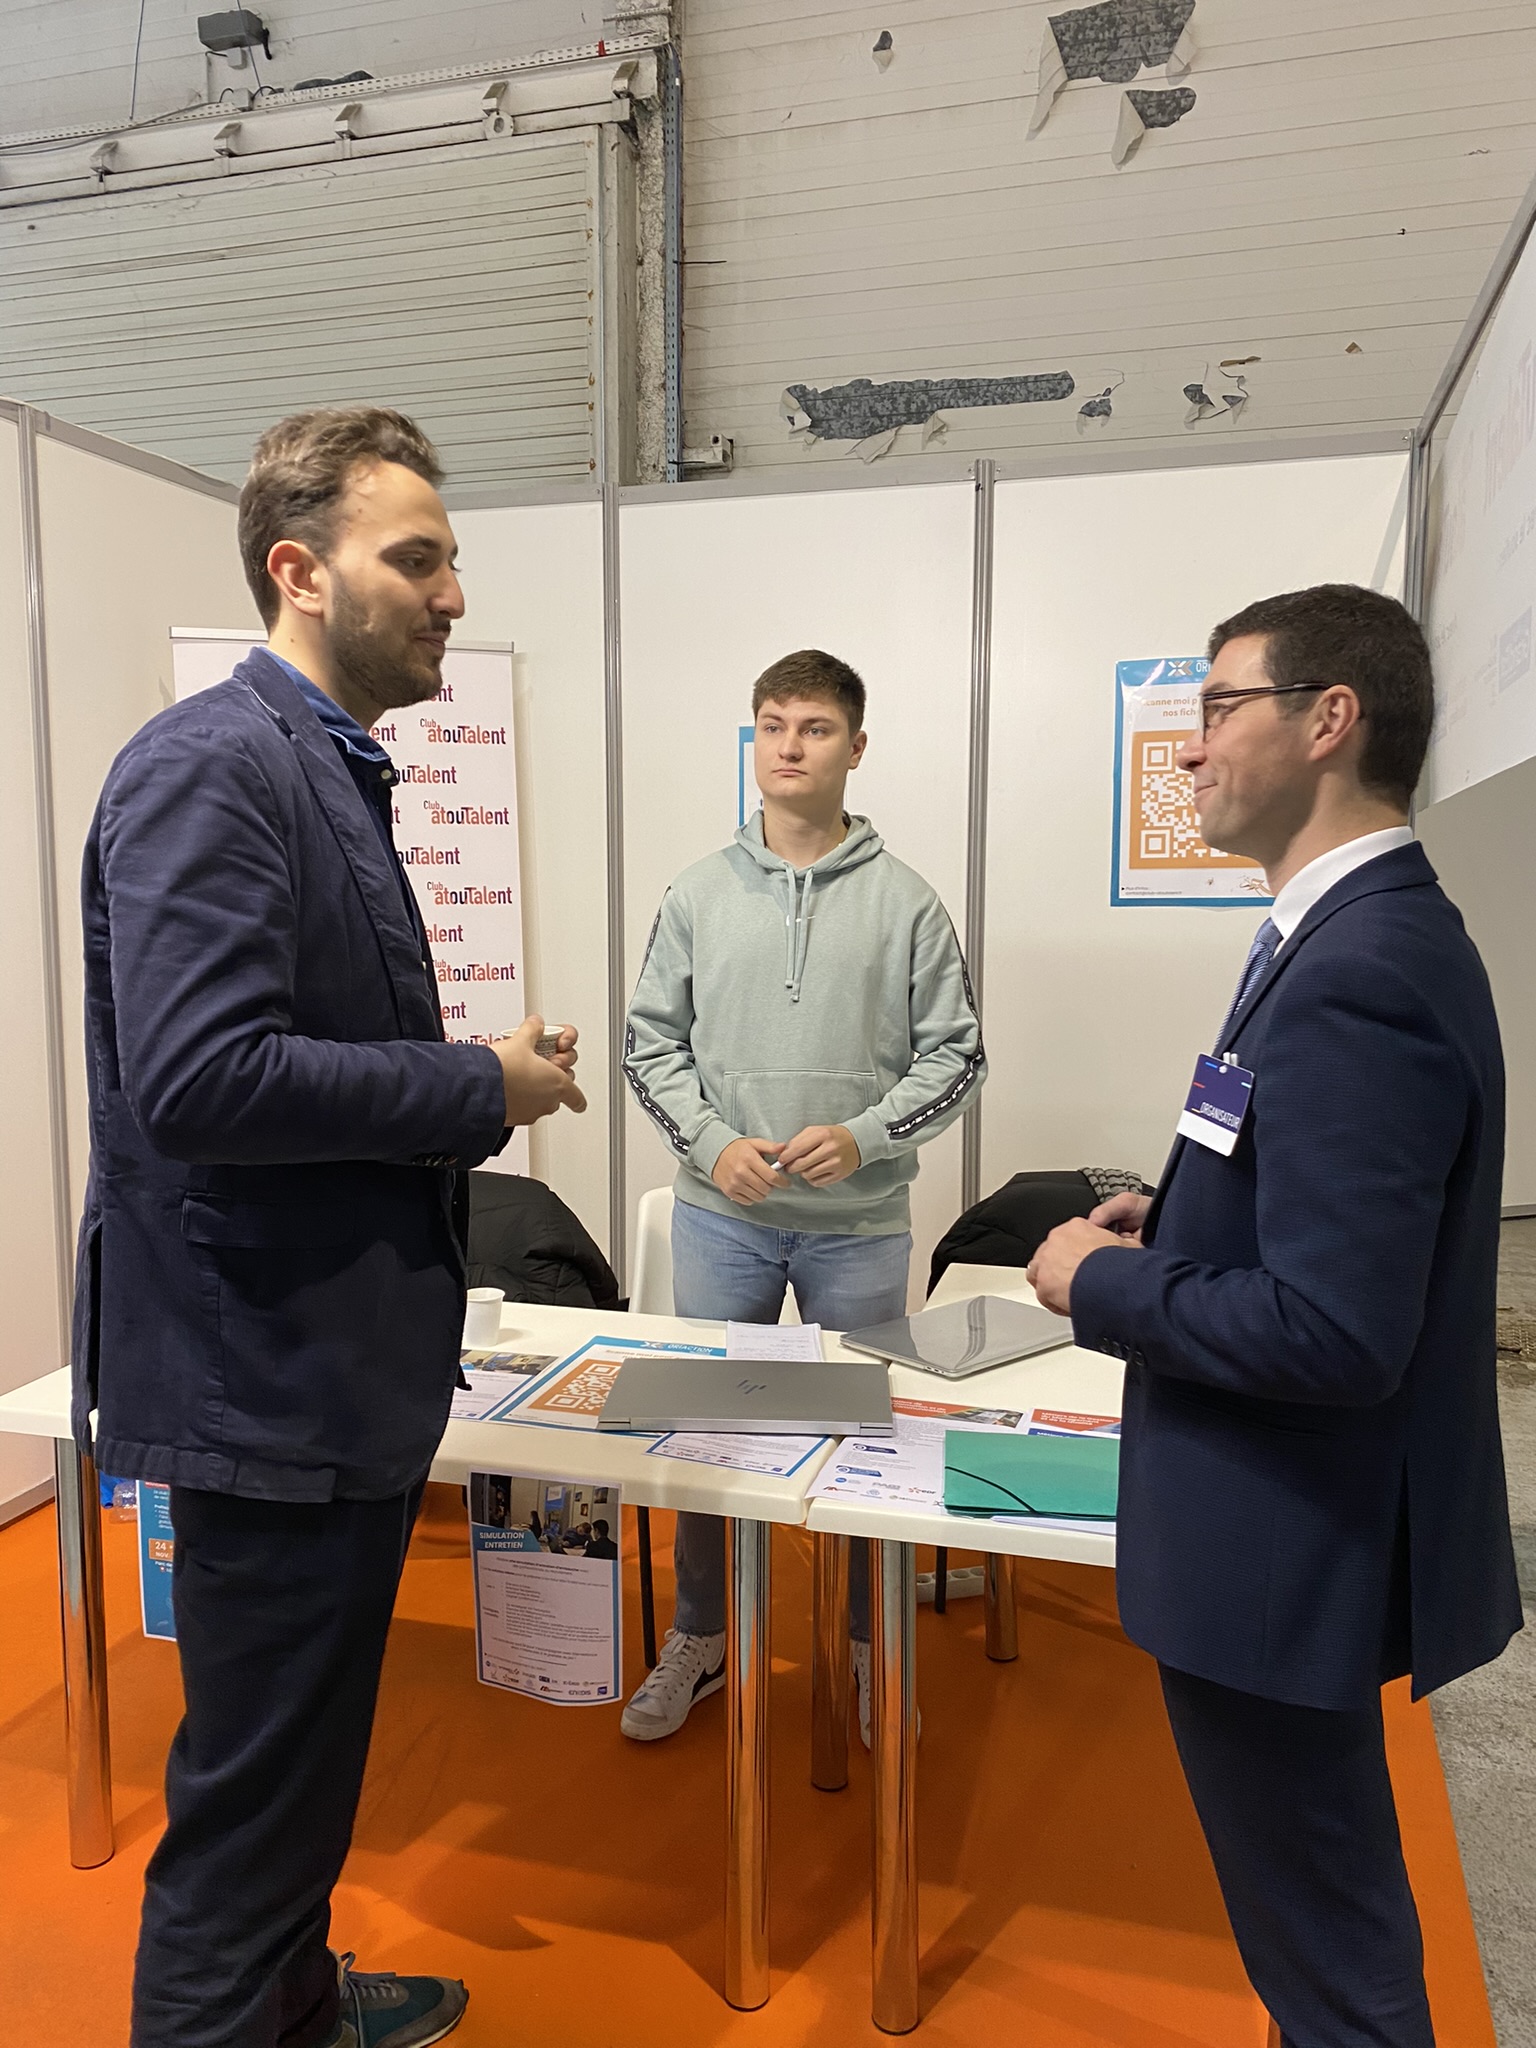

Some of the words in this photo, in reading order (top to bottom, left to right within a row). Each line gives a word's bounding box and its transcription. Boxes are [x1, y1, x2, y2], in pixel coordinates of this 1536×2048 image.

[1180, 708, 1196, 716] fich
[420, 718, 436, 728] Club
[428, 725, 506, 744] atouTalent
[394, 764, 457, 784] ouTalent
[424, 800, 440, 810] Club
[431, 806, 509, 825] atouTalent
[397, 846, 460, 865] ouTalent
[427, 881, 443, 891] Club
[434, 886, 512, 905] atouTalent
[433, 959, 447, 968] lub
[438, 962, 515, 982] atouTalent
[155, 1541, 167, 1551] 24
[484, 1541, 524, 1549] ENTRETIEN
